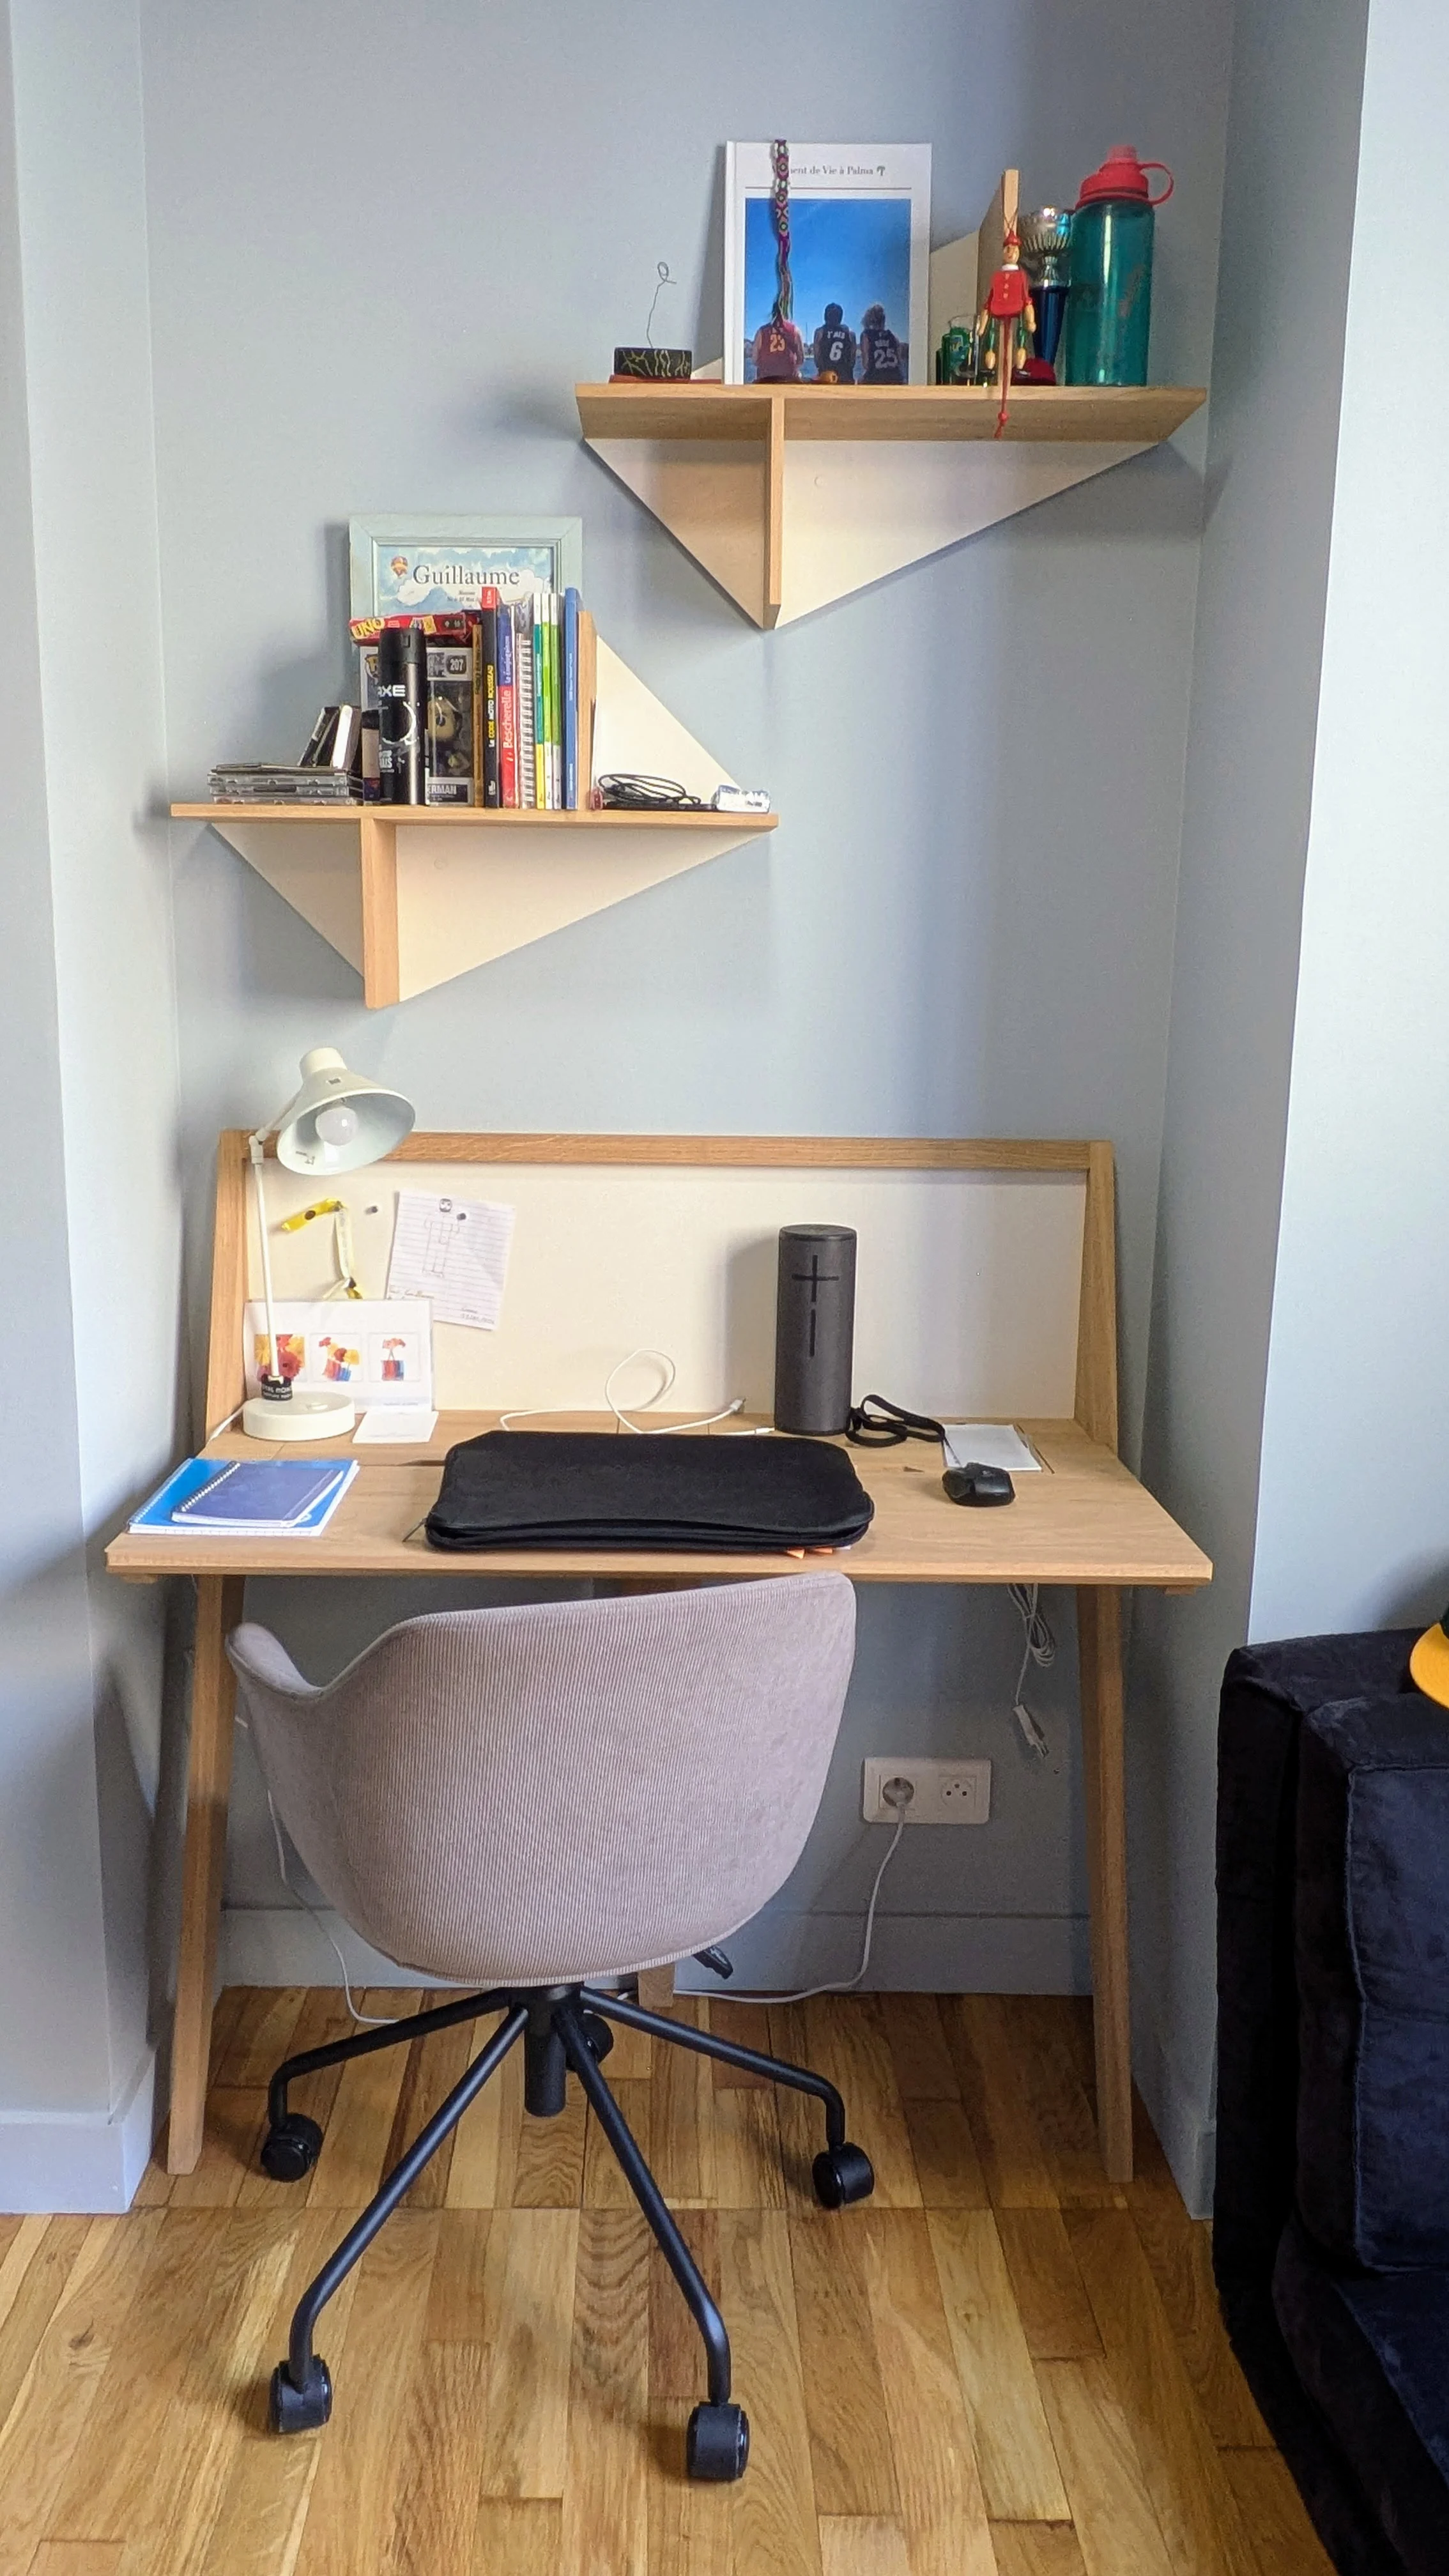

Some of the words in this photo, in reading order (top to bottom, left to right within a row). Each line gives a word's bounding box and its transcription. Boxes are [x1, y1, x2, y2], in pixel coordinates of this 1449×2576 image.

[809, 166, 820, 174] de
[823, 165, 837, 174] Vie
[847, 165, 873, 174] Palma
[830, 341, 843, 361] 6
[874, 348, 898, 369] 25
[413, 565, 519, 585] Guillaume
[354, 618, 383, 637] UNO
[450, 659, 464, 671] 207
[501, 690, 513, 749] Bescherelle
